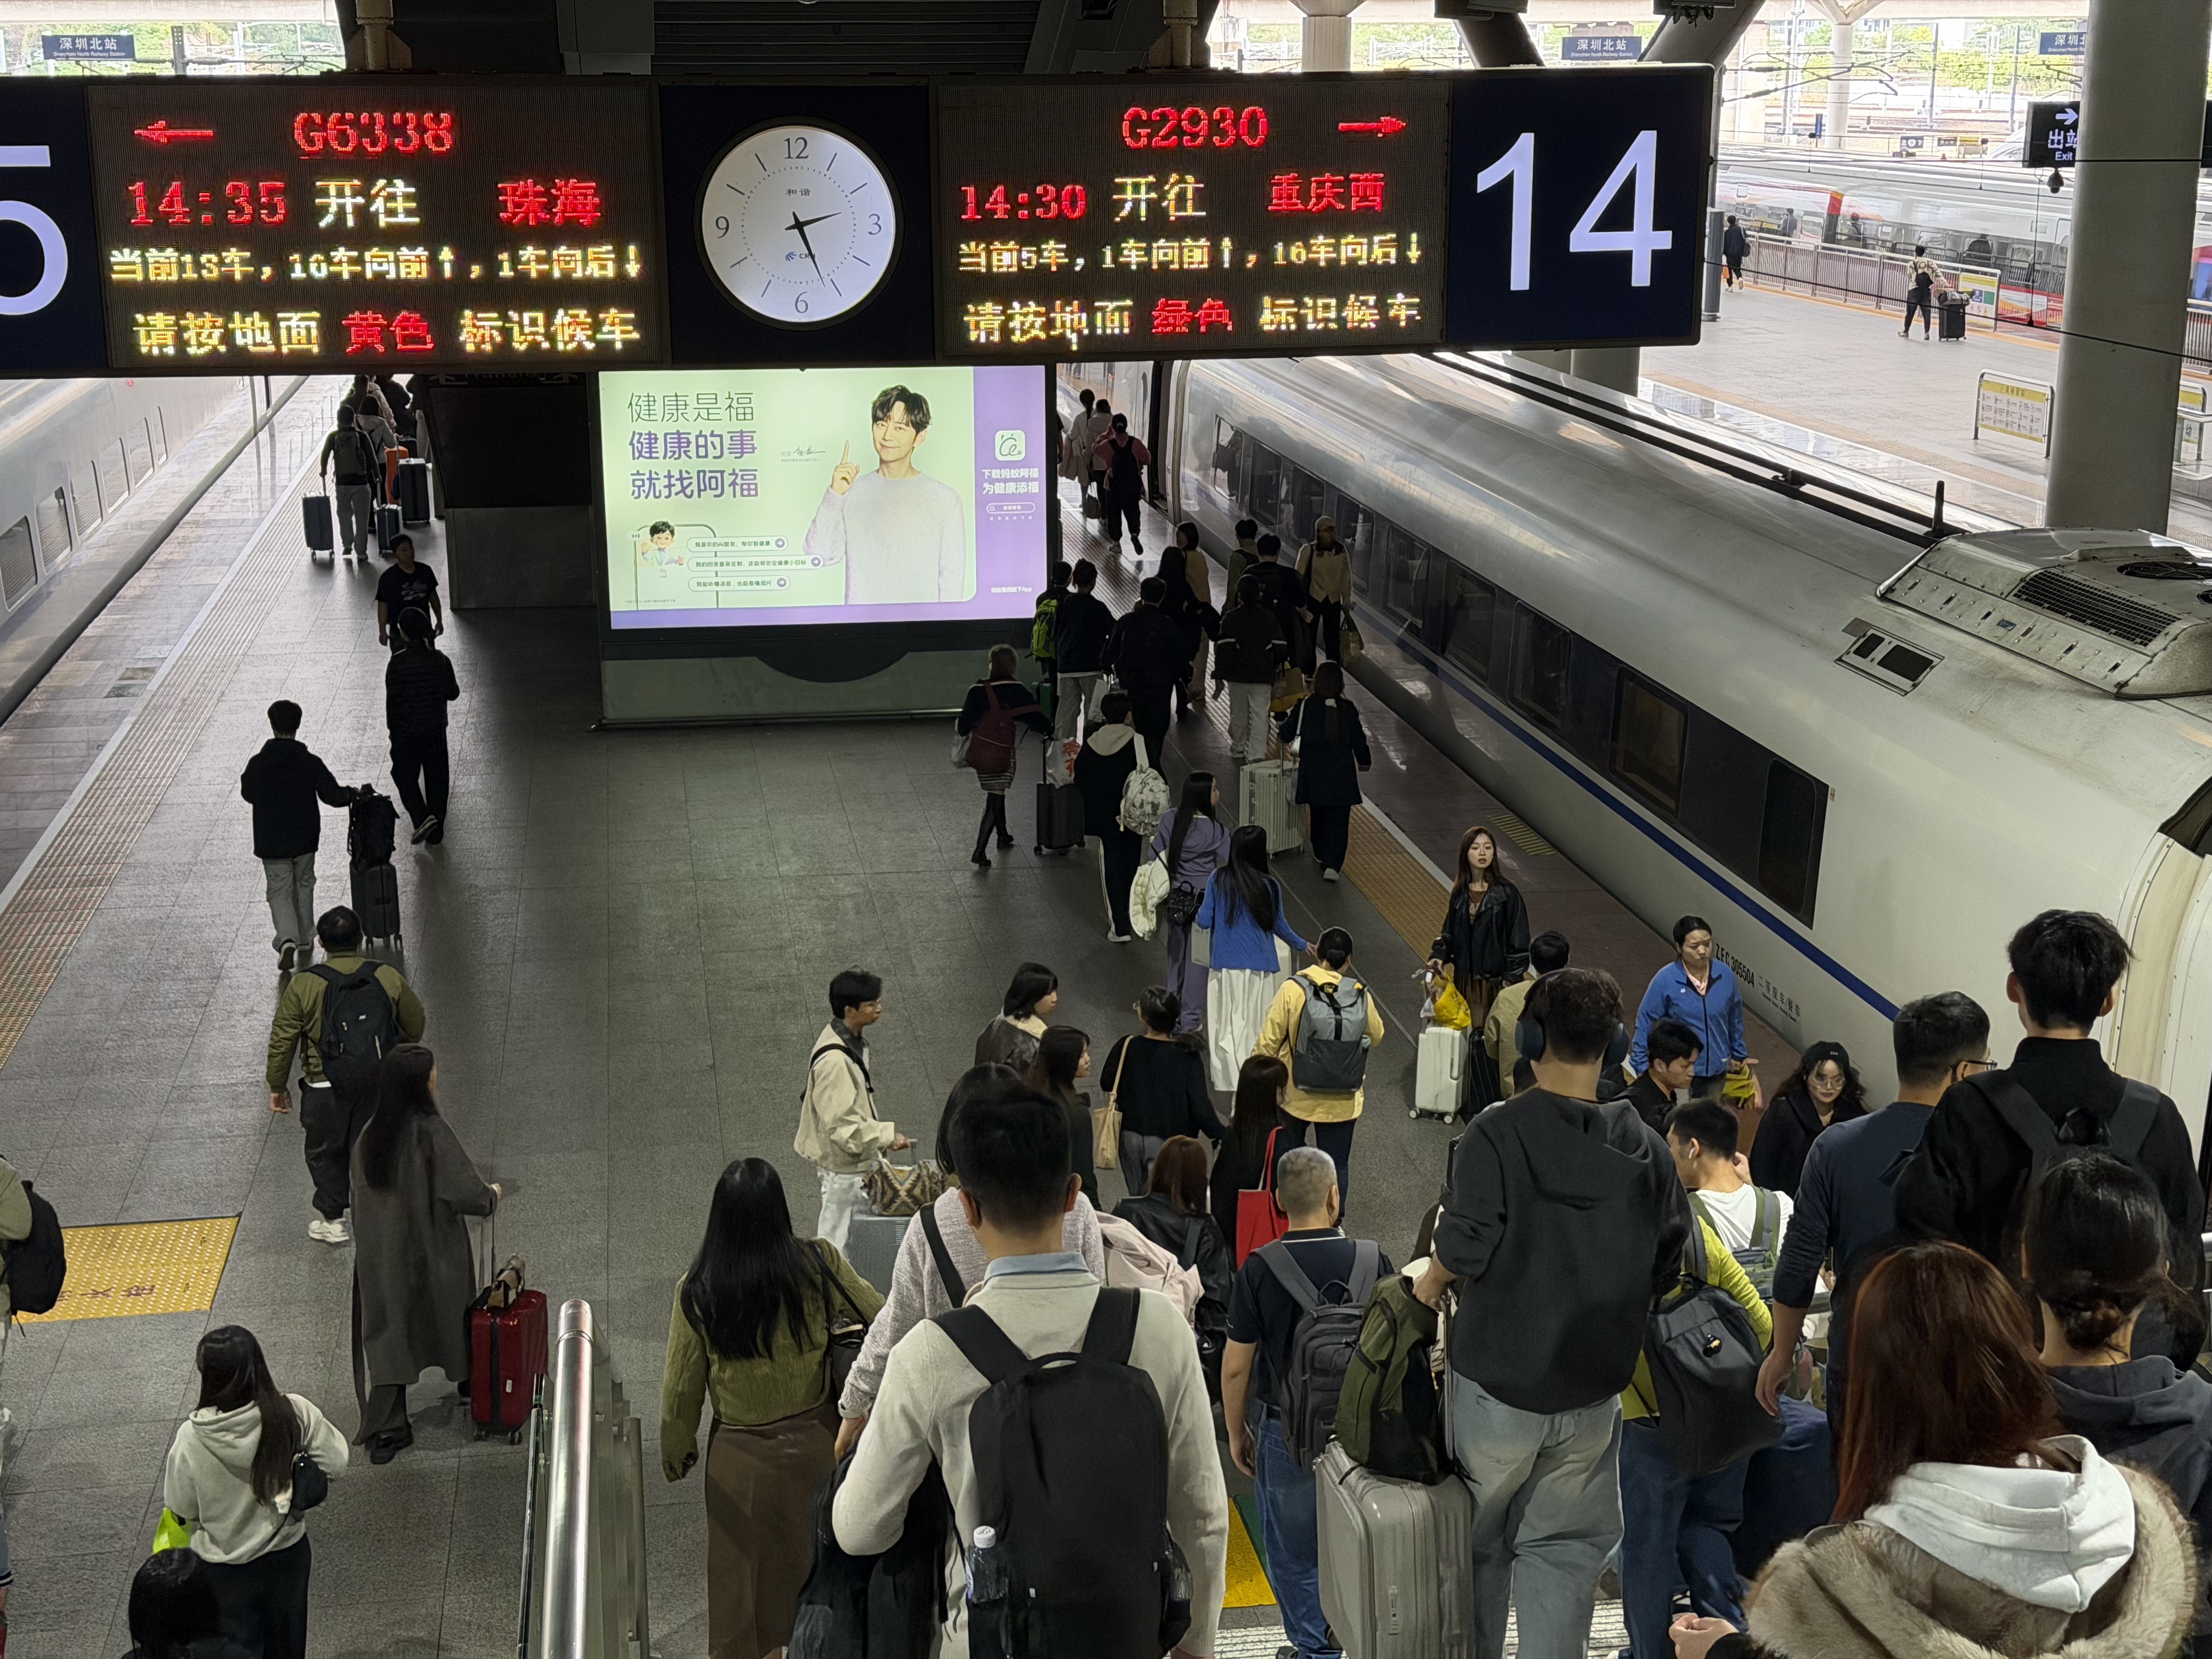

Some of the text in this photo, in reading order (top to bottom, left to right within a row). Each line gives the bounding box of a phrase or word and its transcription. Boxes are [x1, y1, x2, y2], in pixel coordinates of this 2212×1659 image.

[59, 37, 117, 50] 深圳北站
[1577, 38, 1627, 51] 深圳北站
[294, 112, 454, 153] G6338
[1122, 106, 1269, 149] G2930
[783, 137, 809, 159] 12
[2055, 151, 2073, 161] Exit
[128, 179, 602, 228] 14:35 开往 珠海
[785, 188, 811, 196] 和谐
[961, 173, 1385, 222] 14:30 开往 重庆西
[1477, 130, 1672, 290] 14
[715, 216, 730, 239] 9
[868, 213, 882, 235] 3
[794, 291, 809, 313] 6
[133, 308, 640, 356] 请按地面 黄色 标识候车
[627, 391, 754, 422] 健康是福
[628, 429, 758, 460] 健康的事
[630, 467, 759, 500] 就找阿福
[982, 468, 1039, 479] 下载蚂蚁阿福
[982, 482, 1039, 495] 为健康添福
[1731, 955, 1755, 989] 305504
